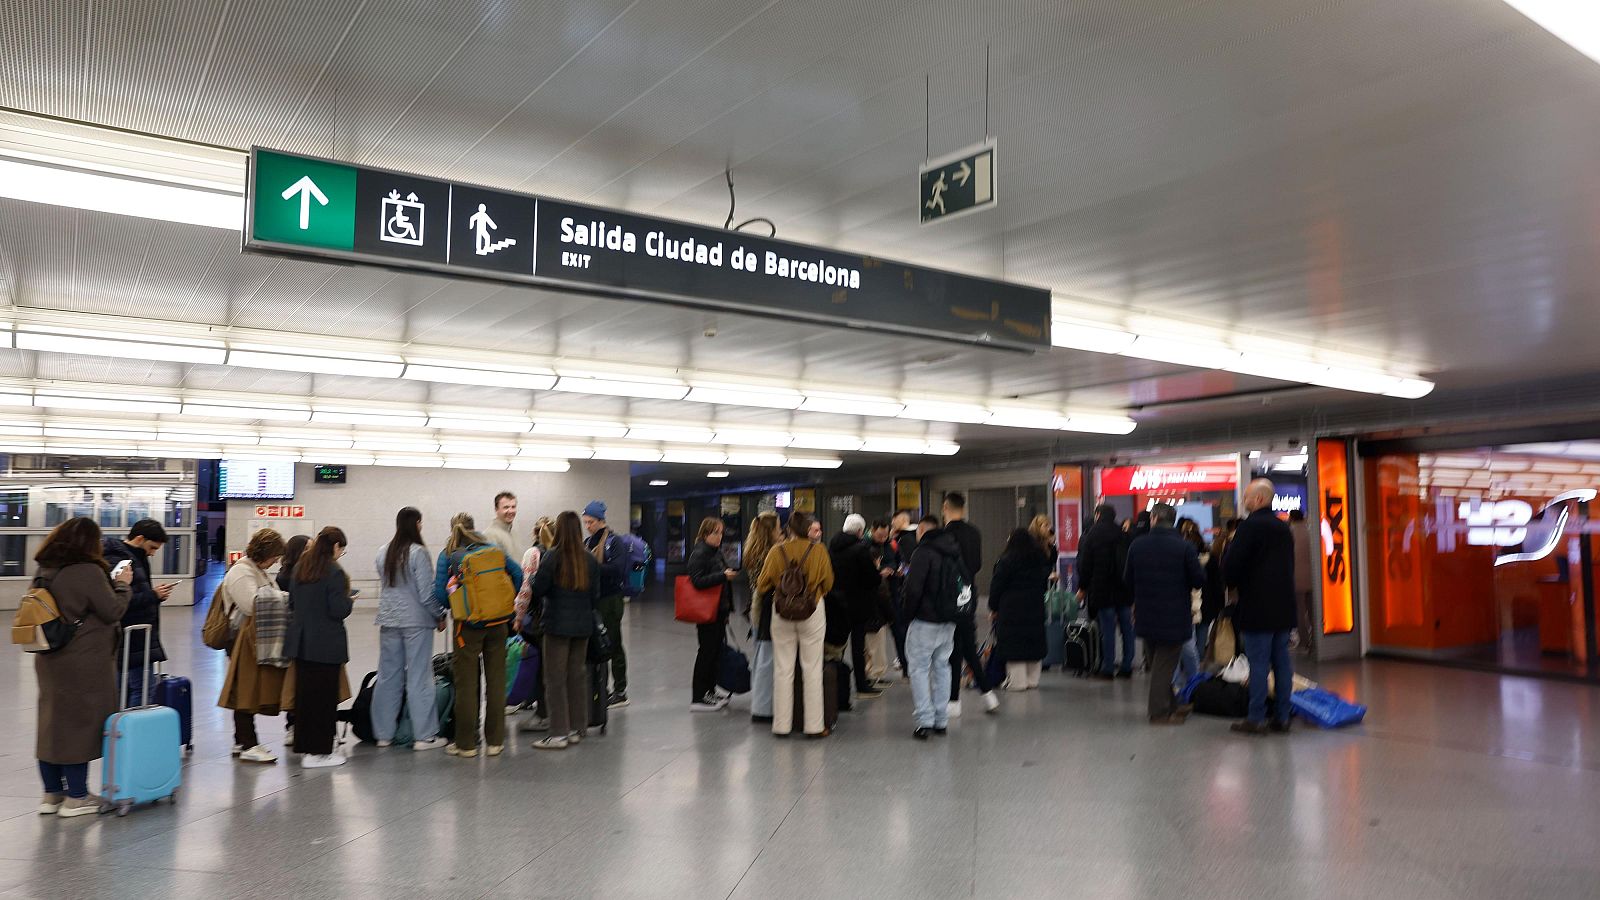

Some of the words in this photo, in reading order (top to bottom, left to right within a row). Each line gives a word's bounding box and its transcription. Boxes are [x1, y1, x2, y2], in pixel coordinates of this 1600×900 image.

[560, 217, 636, 253] Salida
[645, 231, 723, 267] Ciudad
[730, 246, 757, 272] de
[765, 251, 860, 289] Barcelona
[561, 252, 591, 269] EXIT
[1271, 493, 1301, 515] Budget
[1326, 488, 1345, 584] SIXT
